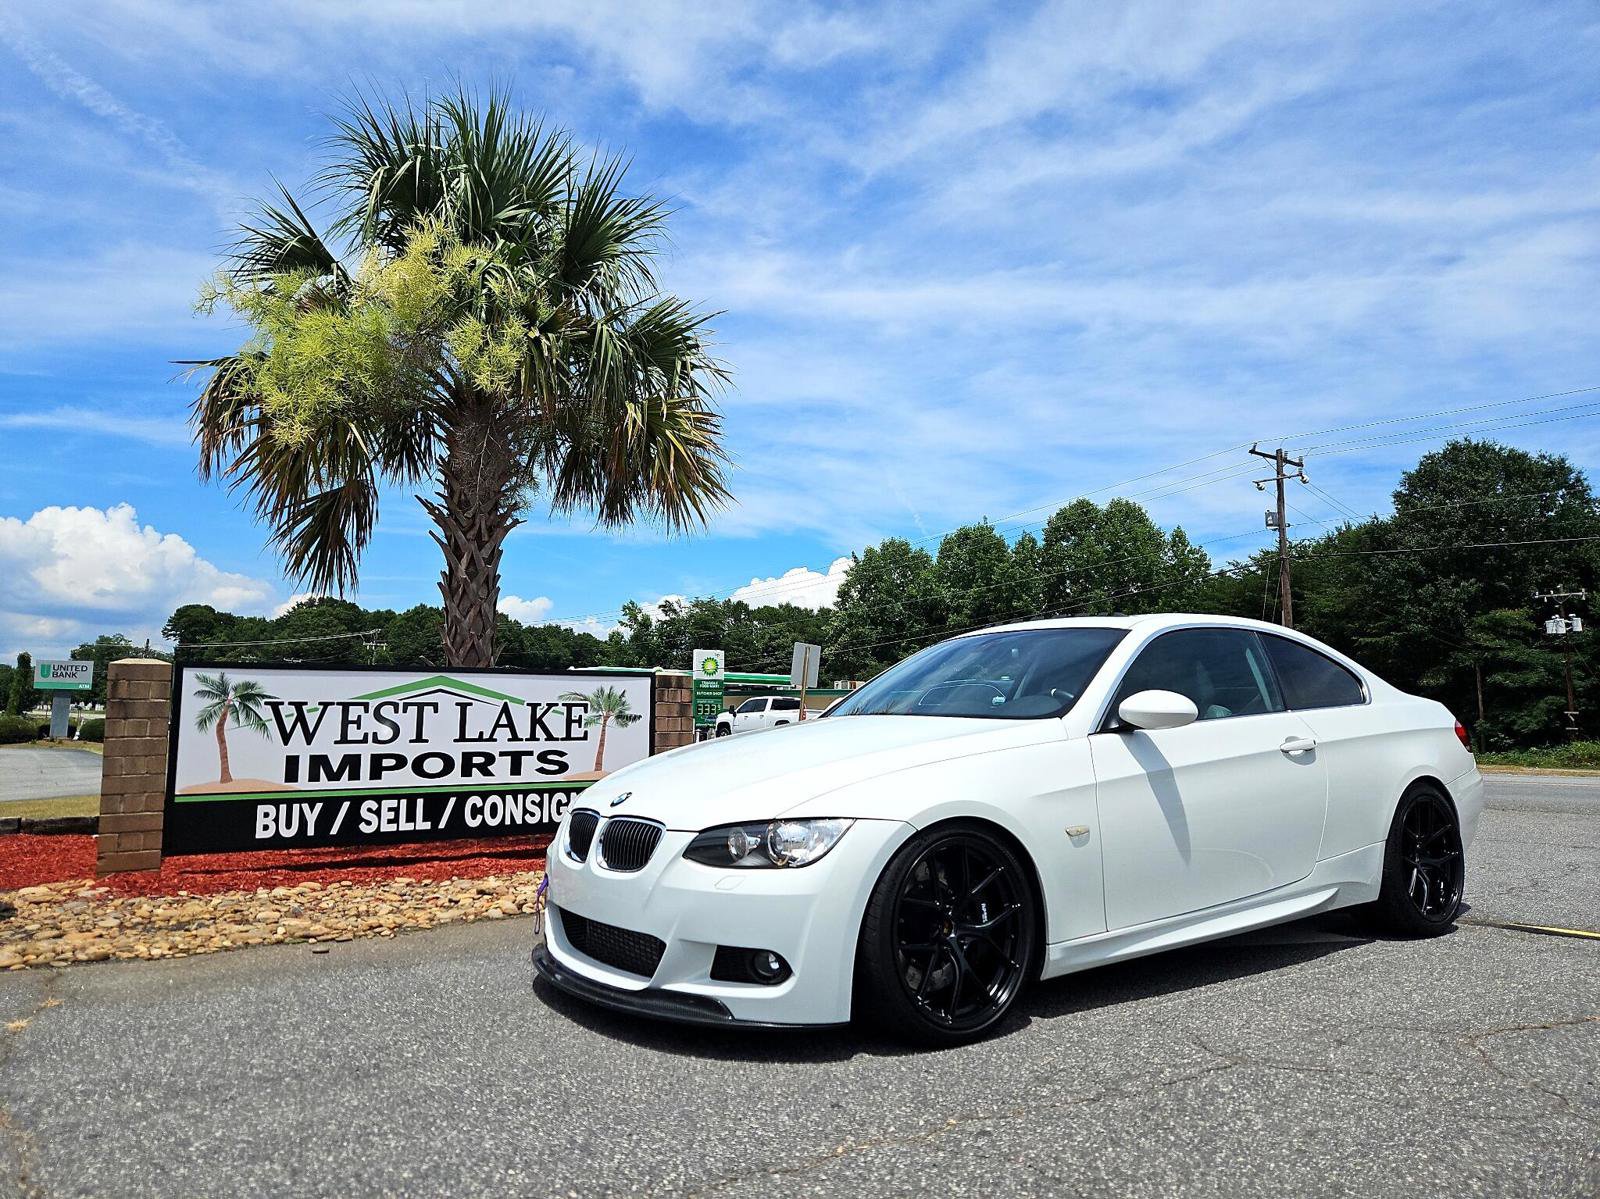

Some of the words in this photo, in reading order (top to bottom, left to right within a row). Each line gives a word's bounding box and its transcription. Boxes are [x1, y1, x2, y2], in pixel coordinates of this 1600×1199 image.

[52, 664, 88, 672] UNITED
[264, 701, 439, 747] WEST
[453, 701, 588, 743] LAKE
[284, 750, 570, 784] IMPORTS
[255, 802, 323, 839] BUY
[358, 798, 432, 834] SELL
